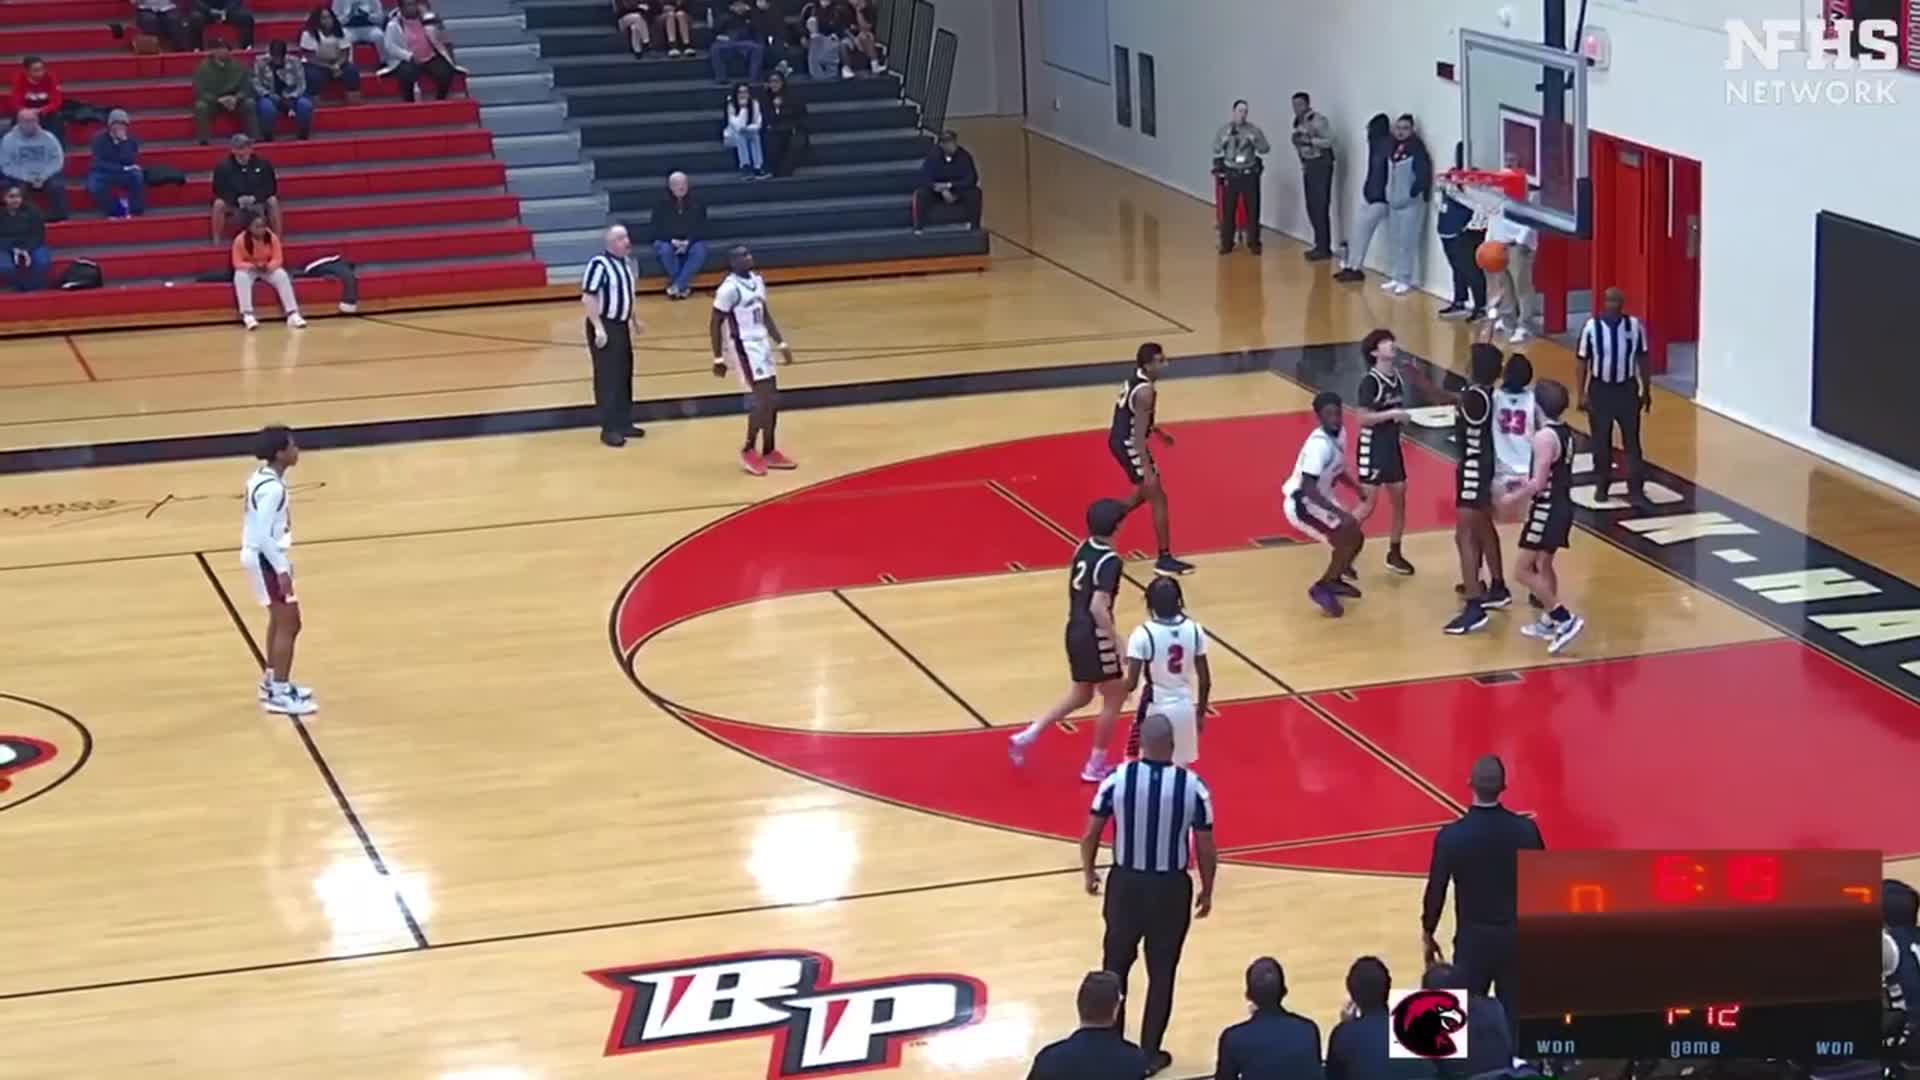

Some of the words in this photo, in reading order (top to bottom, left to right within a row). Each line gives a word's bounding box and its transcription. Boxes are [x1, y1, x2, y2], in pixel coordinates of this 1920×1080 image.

[1498, 408, 1527, 436] 23
[1072, 560, 1087, 591] 2
[1167, 644, 1184, 674] 2
[600, 954, 978, 1074] BP
